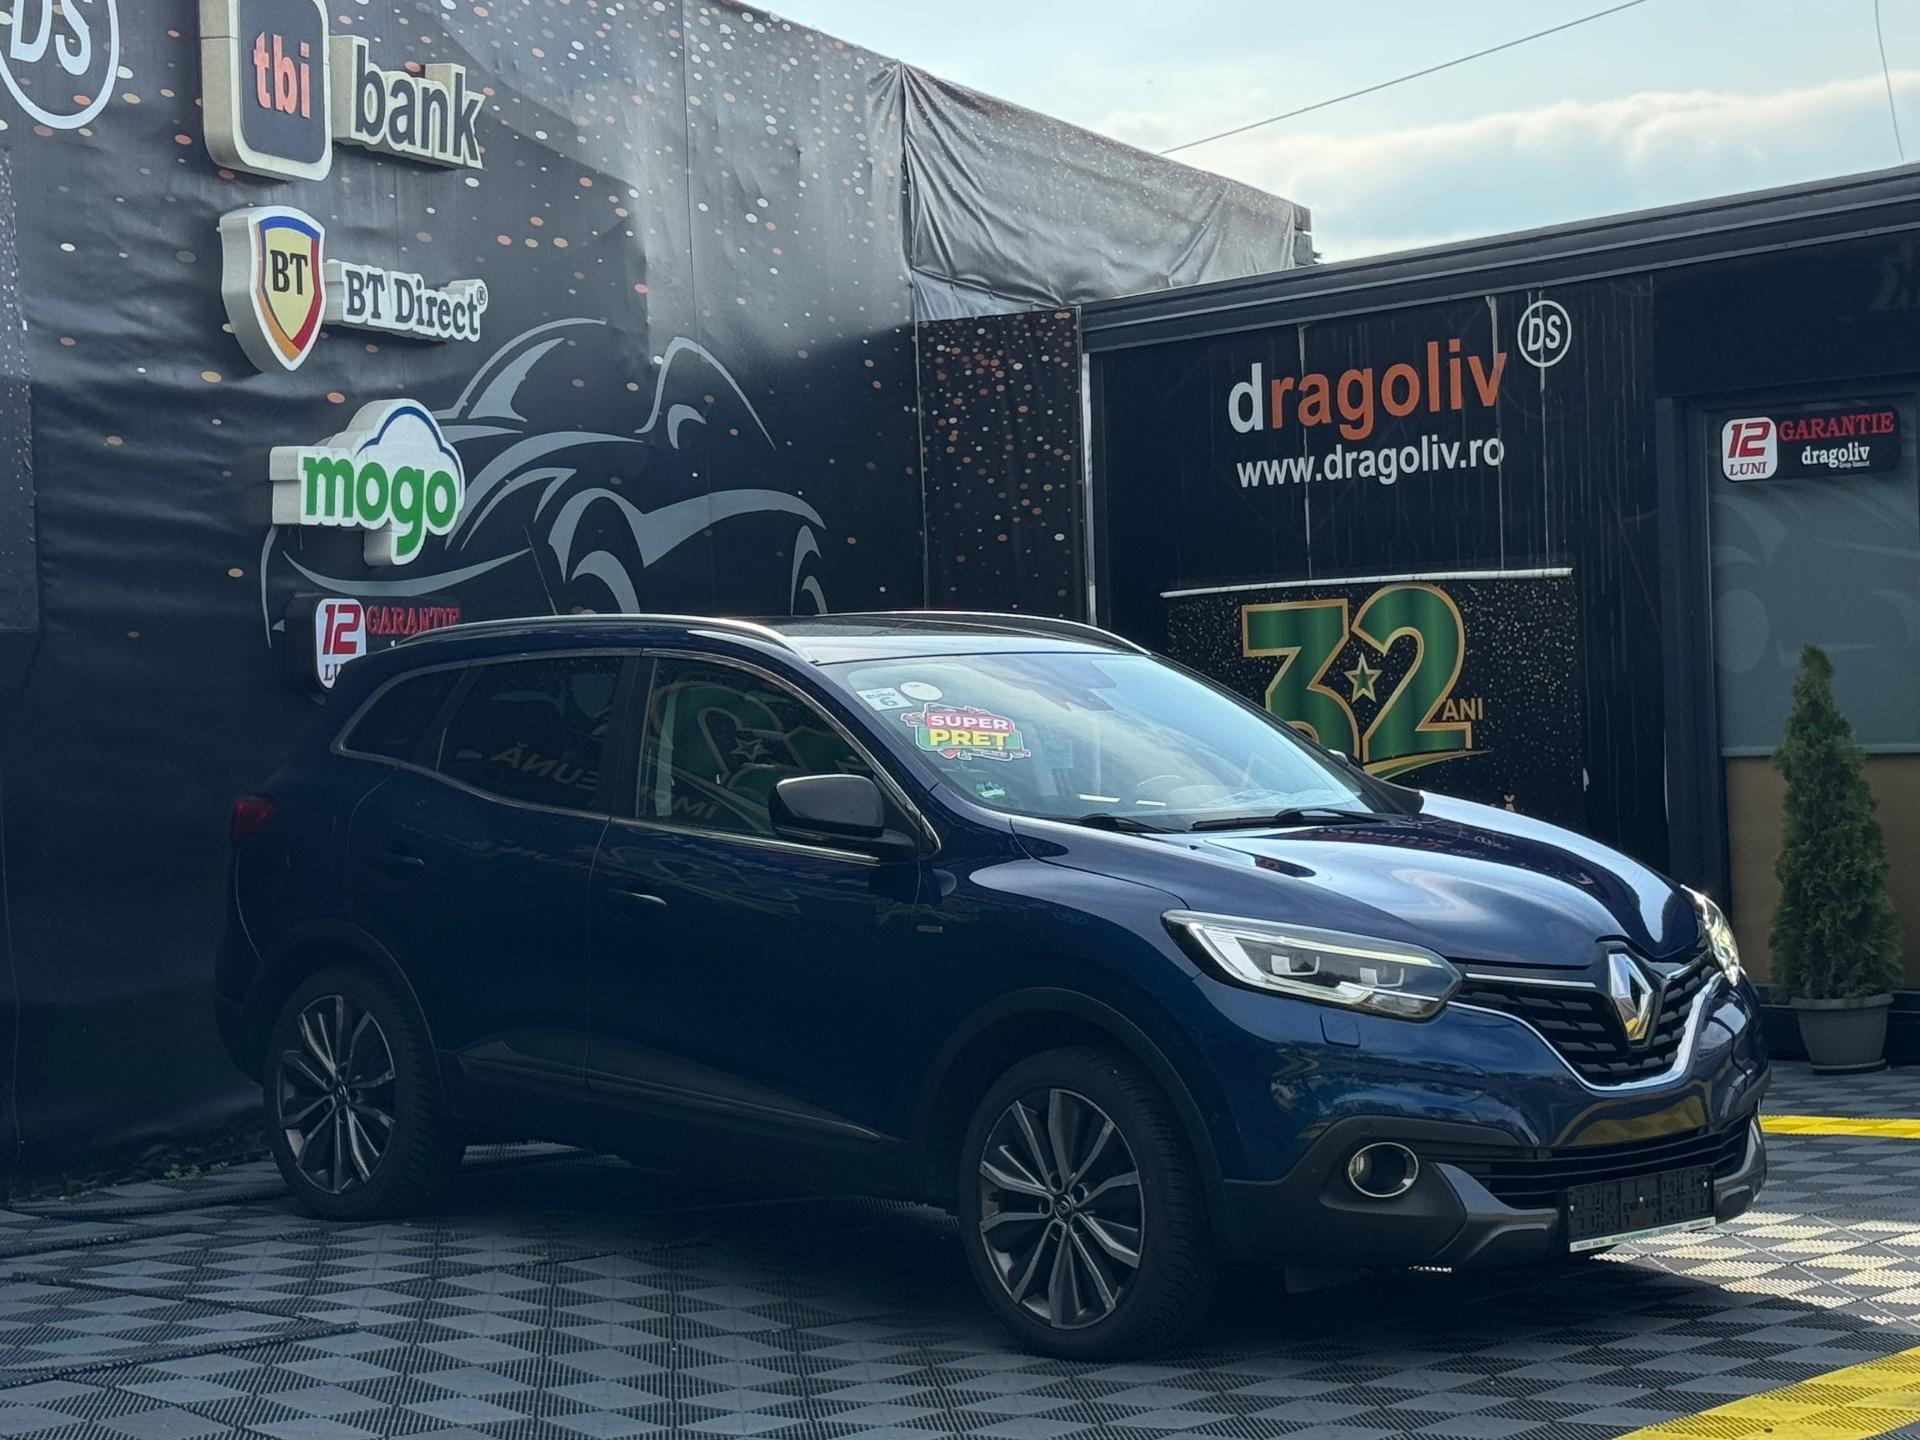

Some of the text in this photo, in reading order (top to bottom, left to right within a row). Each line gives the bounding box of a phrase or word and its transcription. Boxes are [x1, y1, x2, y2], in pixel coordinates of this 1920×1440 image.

[253, 31, 311, 119] tbi
[355, 45, 482, 162] bank
[270, 248, 308, 295] BT
[345, 269, 385, 319] BT
[1527, 313, 1562, 352] DS
[1228, 338, 1508, 441] dragoliv
[1728, 413, 1894, 458] 12 GARANTIE
[1801, 443, 1871, 468] dragoliv
[1236, 436, 1505, 488] www.dragoliv.ro
[1729, 462, 1767, 476] LUNI
[303, 457, 456, 555] mogo
[323, 604, 361, 655] 12
[1241, 583, 1473, 764] 32
[880, 697, 898, 707] 6
[931, 715, 1010, 730] SUPER
[1441, 697, 1484, 721] ANI
